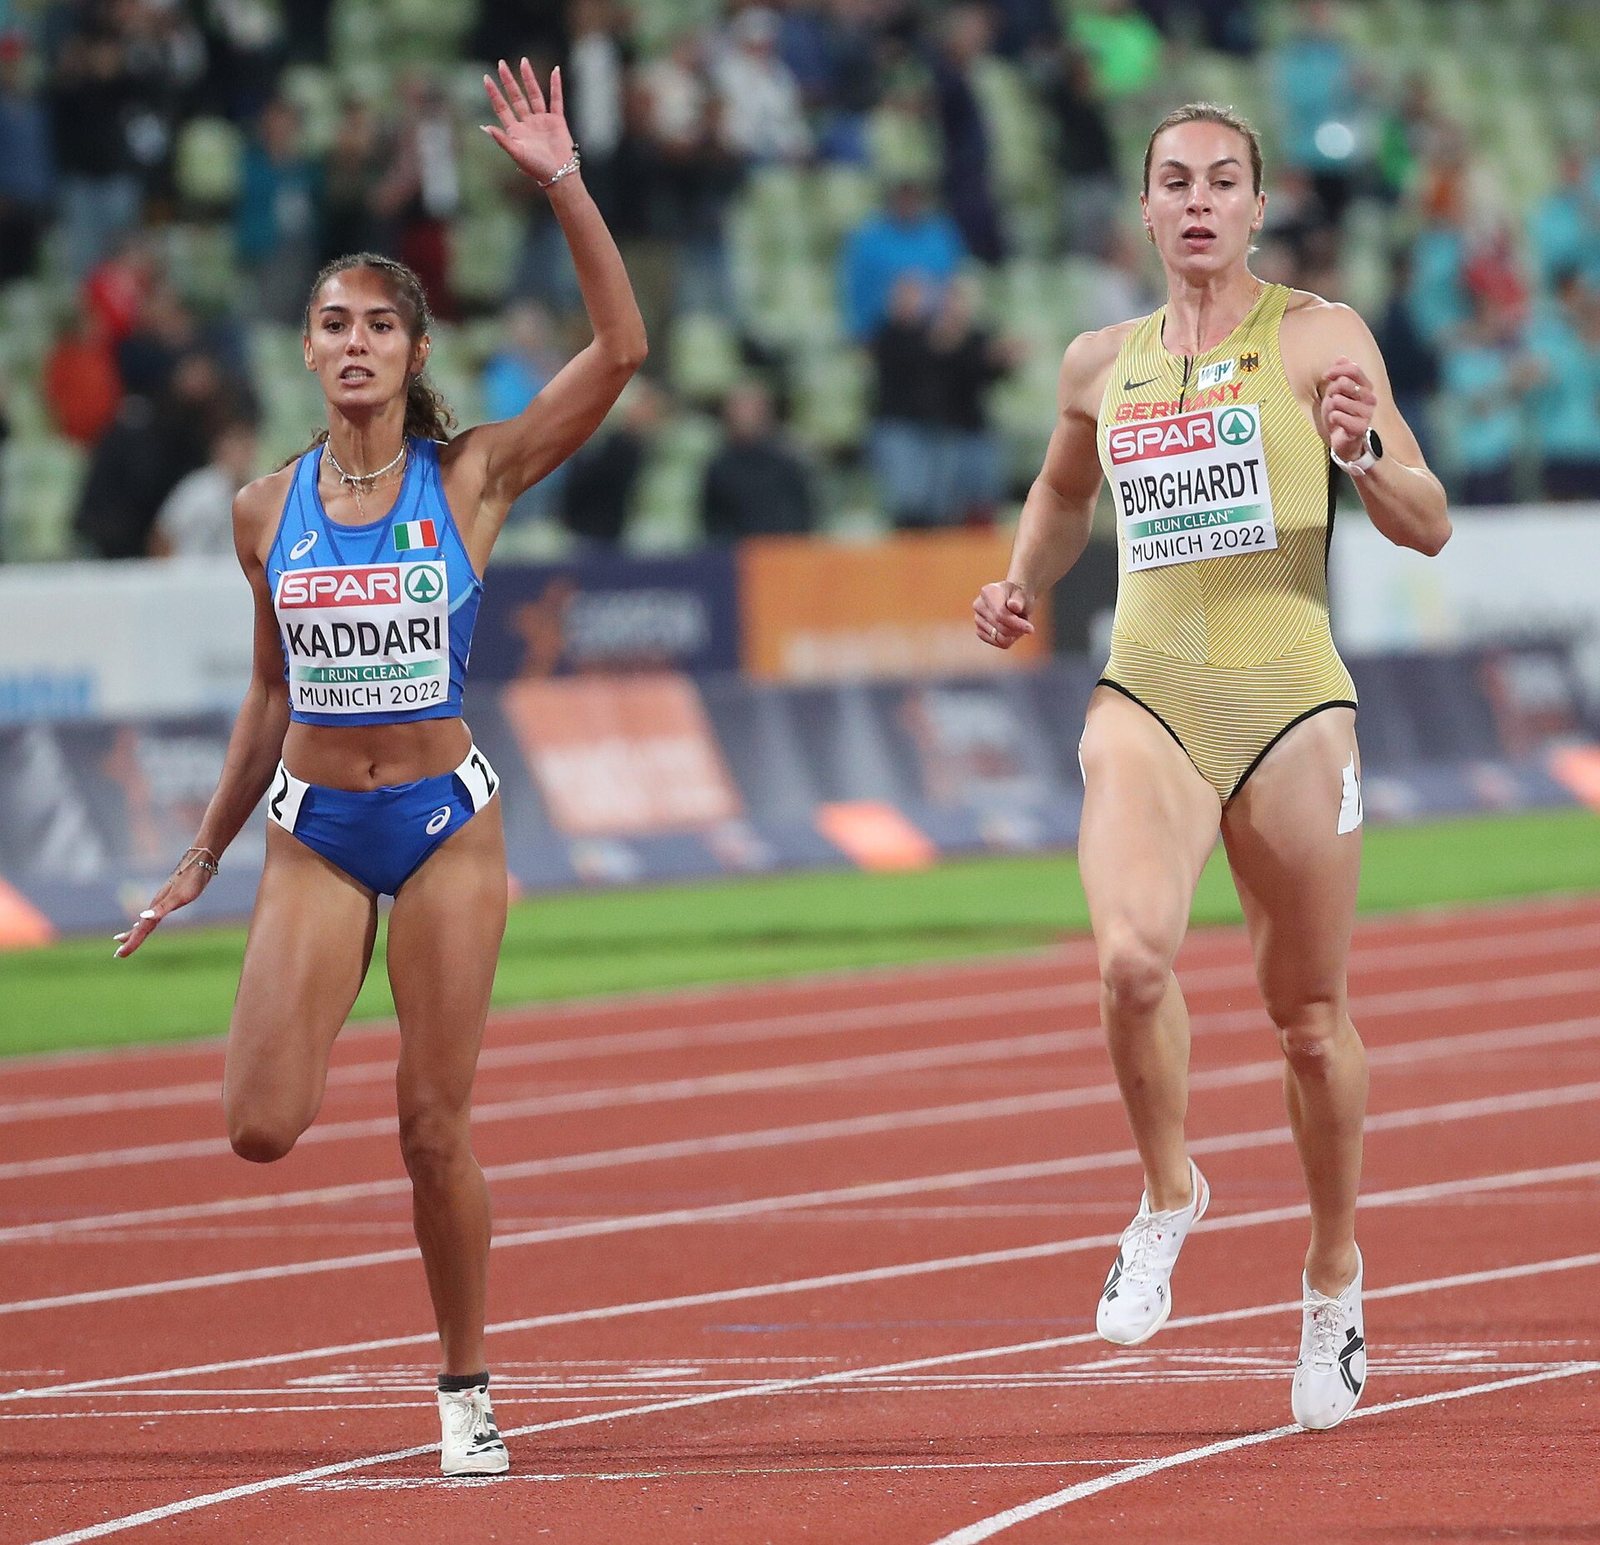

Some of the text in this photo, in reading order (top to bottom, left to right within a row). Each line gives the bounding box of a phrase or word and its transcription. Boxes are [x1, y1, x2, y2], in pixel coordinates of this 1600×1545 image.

[1116, 382, 1242, 420] GERMANY
[1111, 417, 1213, 459] SPAR
[1119, 459, 1259, 516] BURGHARDT
[1132, 525, 1266, 564] MUNICH 2022
[1154, 518, 1181, 533] RUN
[282, 572, 398, 604] SPAR
[286, 616, 441, 658] KADDARI
[300, 680, 441, 707] MUNICH 2022
[328, 668, 358, 681] RUN
